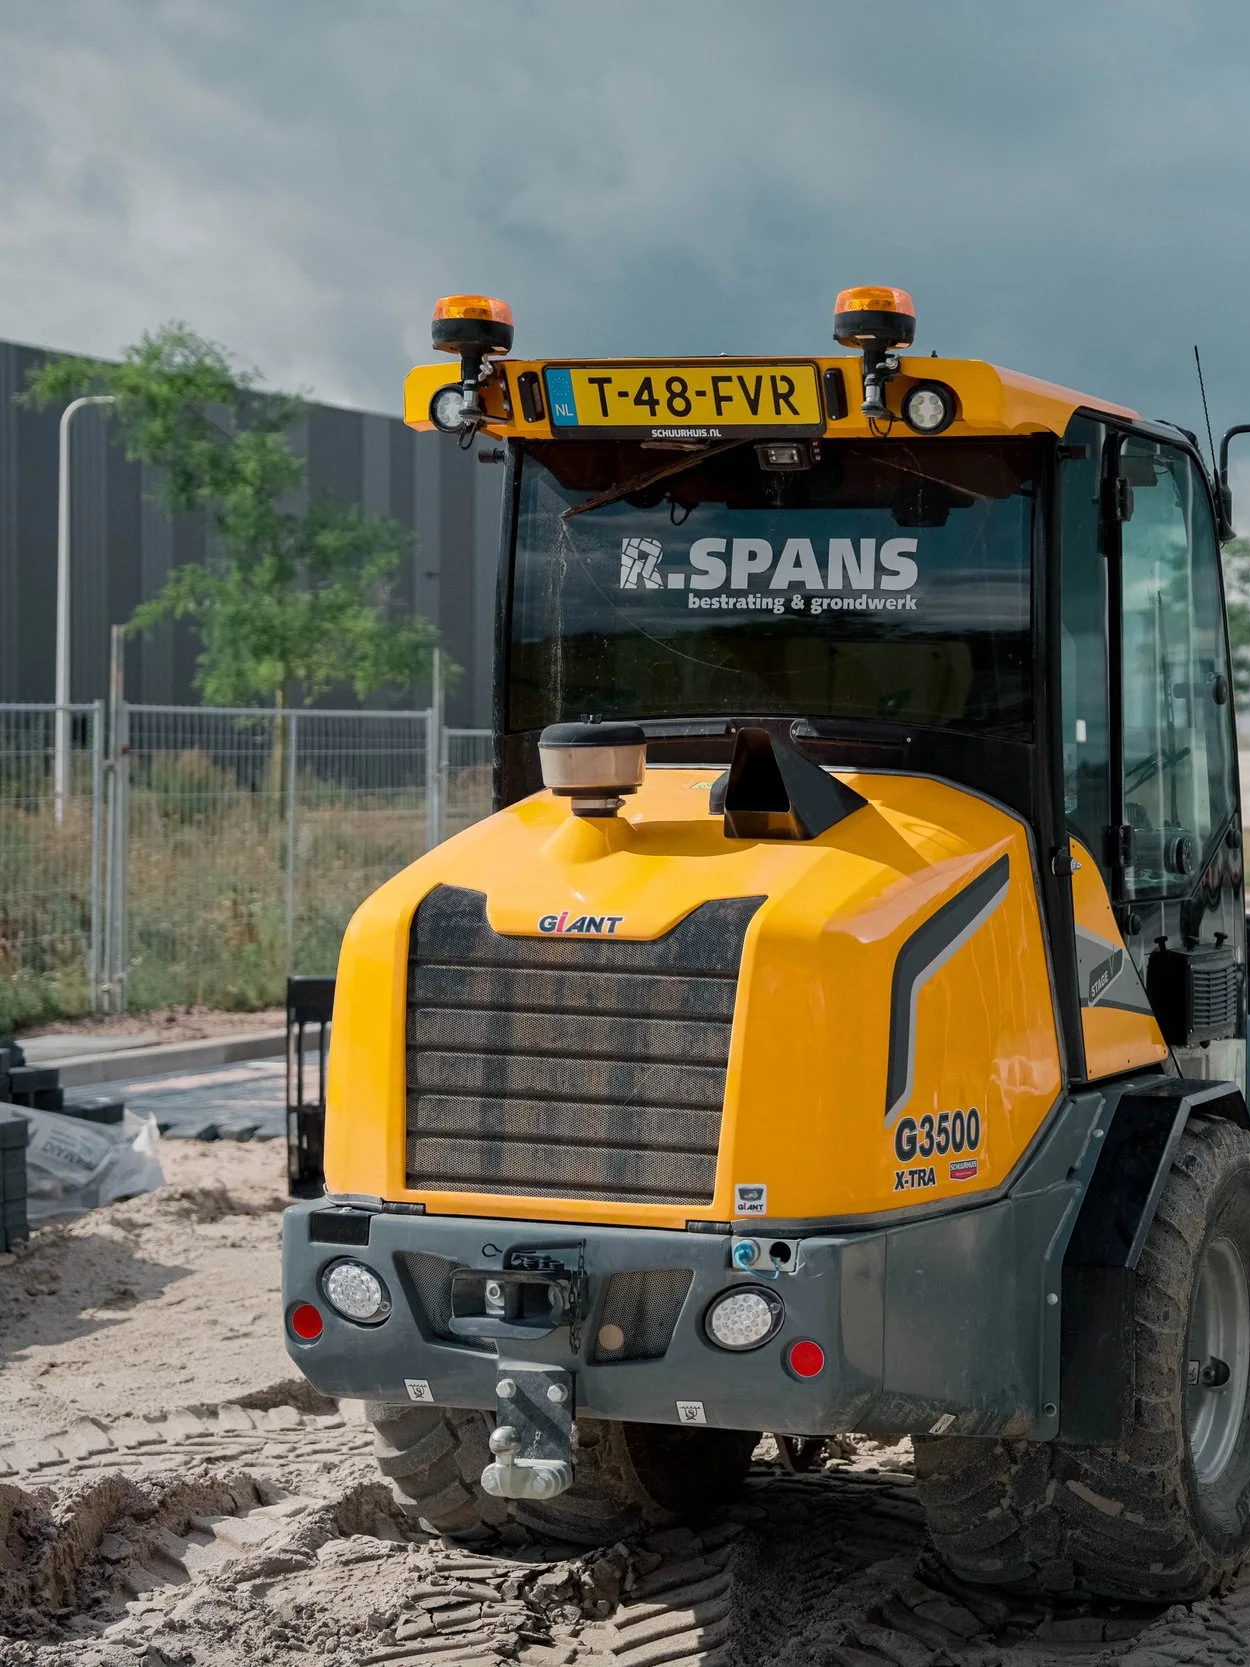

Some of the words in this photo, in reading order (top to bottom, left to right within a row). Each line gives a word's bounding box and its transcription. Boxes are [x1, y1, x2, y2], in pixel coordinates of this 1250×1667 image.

[555, 404, 573, 416] NL
[588, 375, 800, 418] T-48-FVR
[620, 538, 918, 590] R.SPANS
[688, 593, 784, 614] bestrating
[791, 594, 804, 610] &
[811, 593, 917, 614] grondwerk
[1091, 970, 1109, 997] STAGE
[894, 1107, 980, 1163] G3500
[893, 1166, 937, 1192] X-TRA
